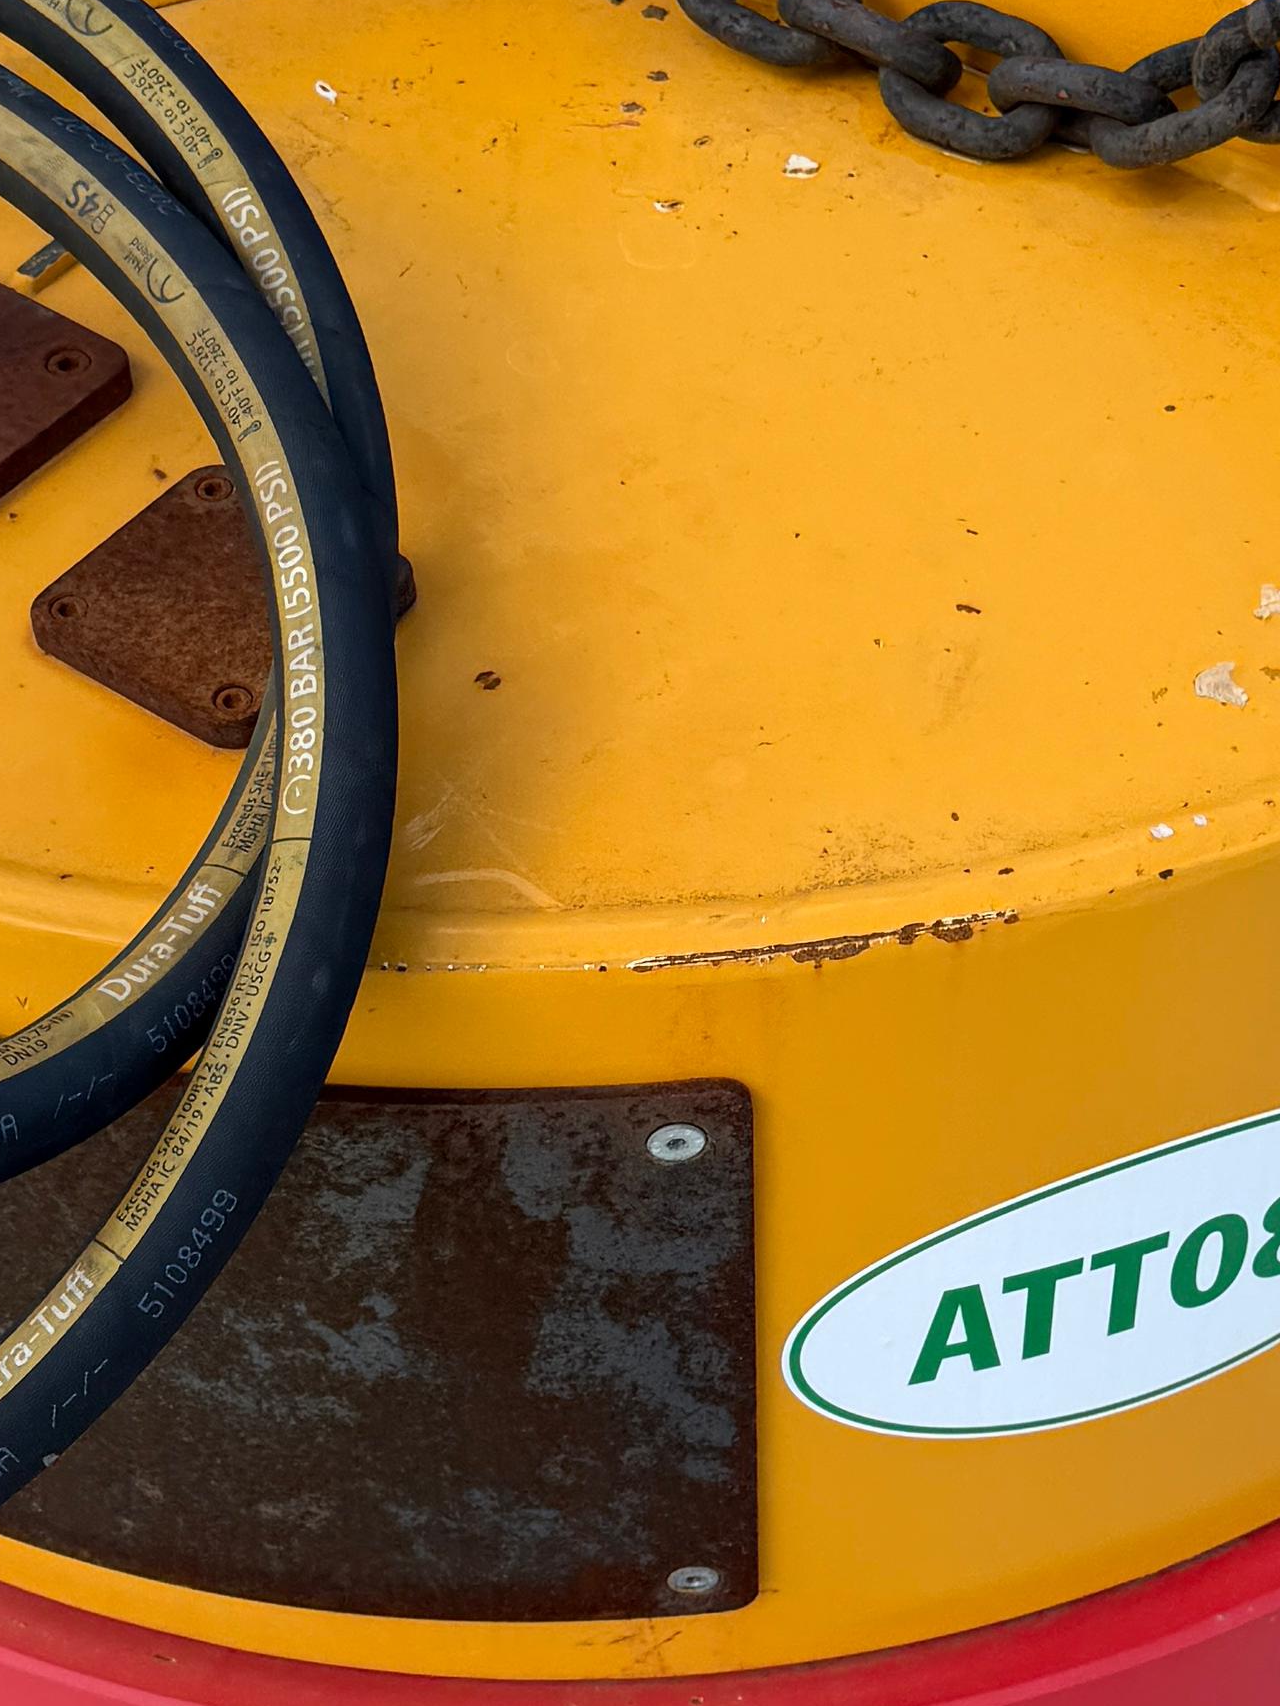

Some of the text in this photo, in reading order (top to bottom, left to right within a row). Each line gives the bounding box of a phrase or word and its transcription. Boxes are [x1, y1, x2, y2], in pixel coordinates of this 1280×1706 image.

[163, 107, 179, 121] to
[175, 99, 191, 113] to
[65, 179, 103, 219] 4S
[221, 186, 270, 249] PSI)
[254, 460, 319, 774] 380 BAR (5500 PSI)
[221, 795, 259, 849] Exceeds
[250, 768, 271, 796] SAE
[235, 809, 271, 855] MSHA
[97, 882, 224, 1002] Dura-Tuff
[0, 1038, 50, 1068] DN19
[115, 1159, 161, 1224] Exceeds
[157, 1125, 181, 1157] SAE
[176, 1060, 214, 1124] 100R12
[213, 997, 241, 1049] EN856
[235, 961, 254, 992] R12
[247, 919, 267, 949] ISO
[261, 864, 282, 913] 18752
[125, 951, 273, 1232] MSHA IC 84/19 ABS DNV USCG
[137, 1189, 240, 1322] 5108499
